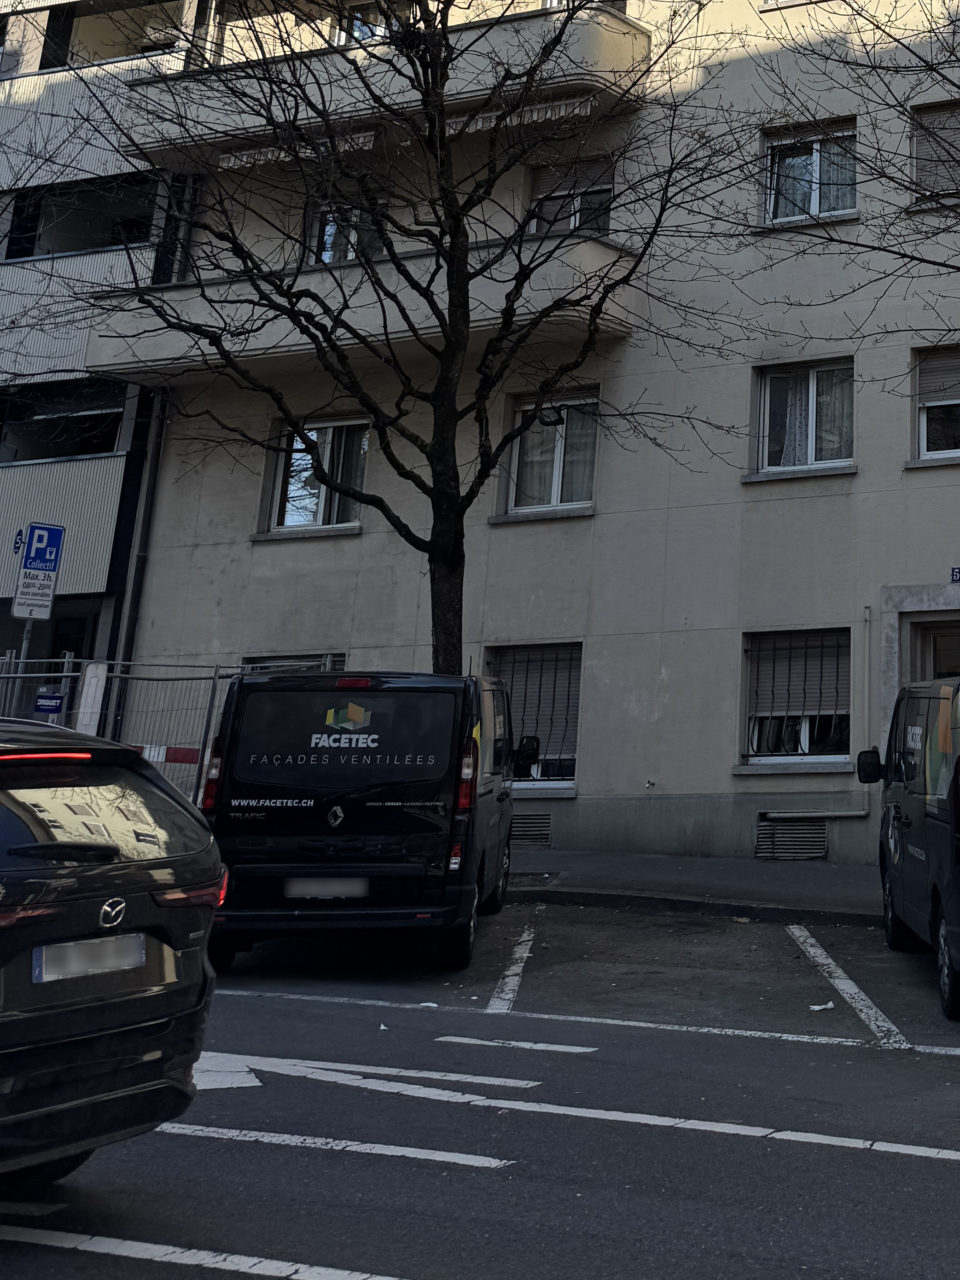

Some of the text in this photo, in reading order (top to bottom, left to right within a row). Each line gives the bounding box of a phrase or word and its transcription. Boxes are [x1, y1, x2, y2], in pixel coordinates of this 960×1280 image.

[30, 529, 49, 558] P
[27, 559, 55, 570] Collectif
[23, 571, 40, 581] Max.
[310, 734, 380, 748] FACETEC
[250, 753, 435, 766] FAÇADES VENTILÉES
[231, 799, 314, 807] WWW.FACETEC.CH
